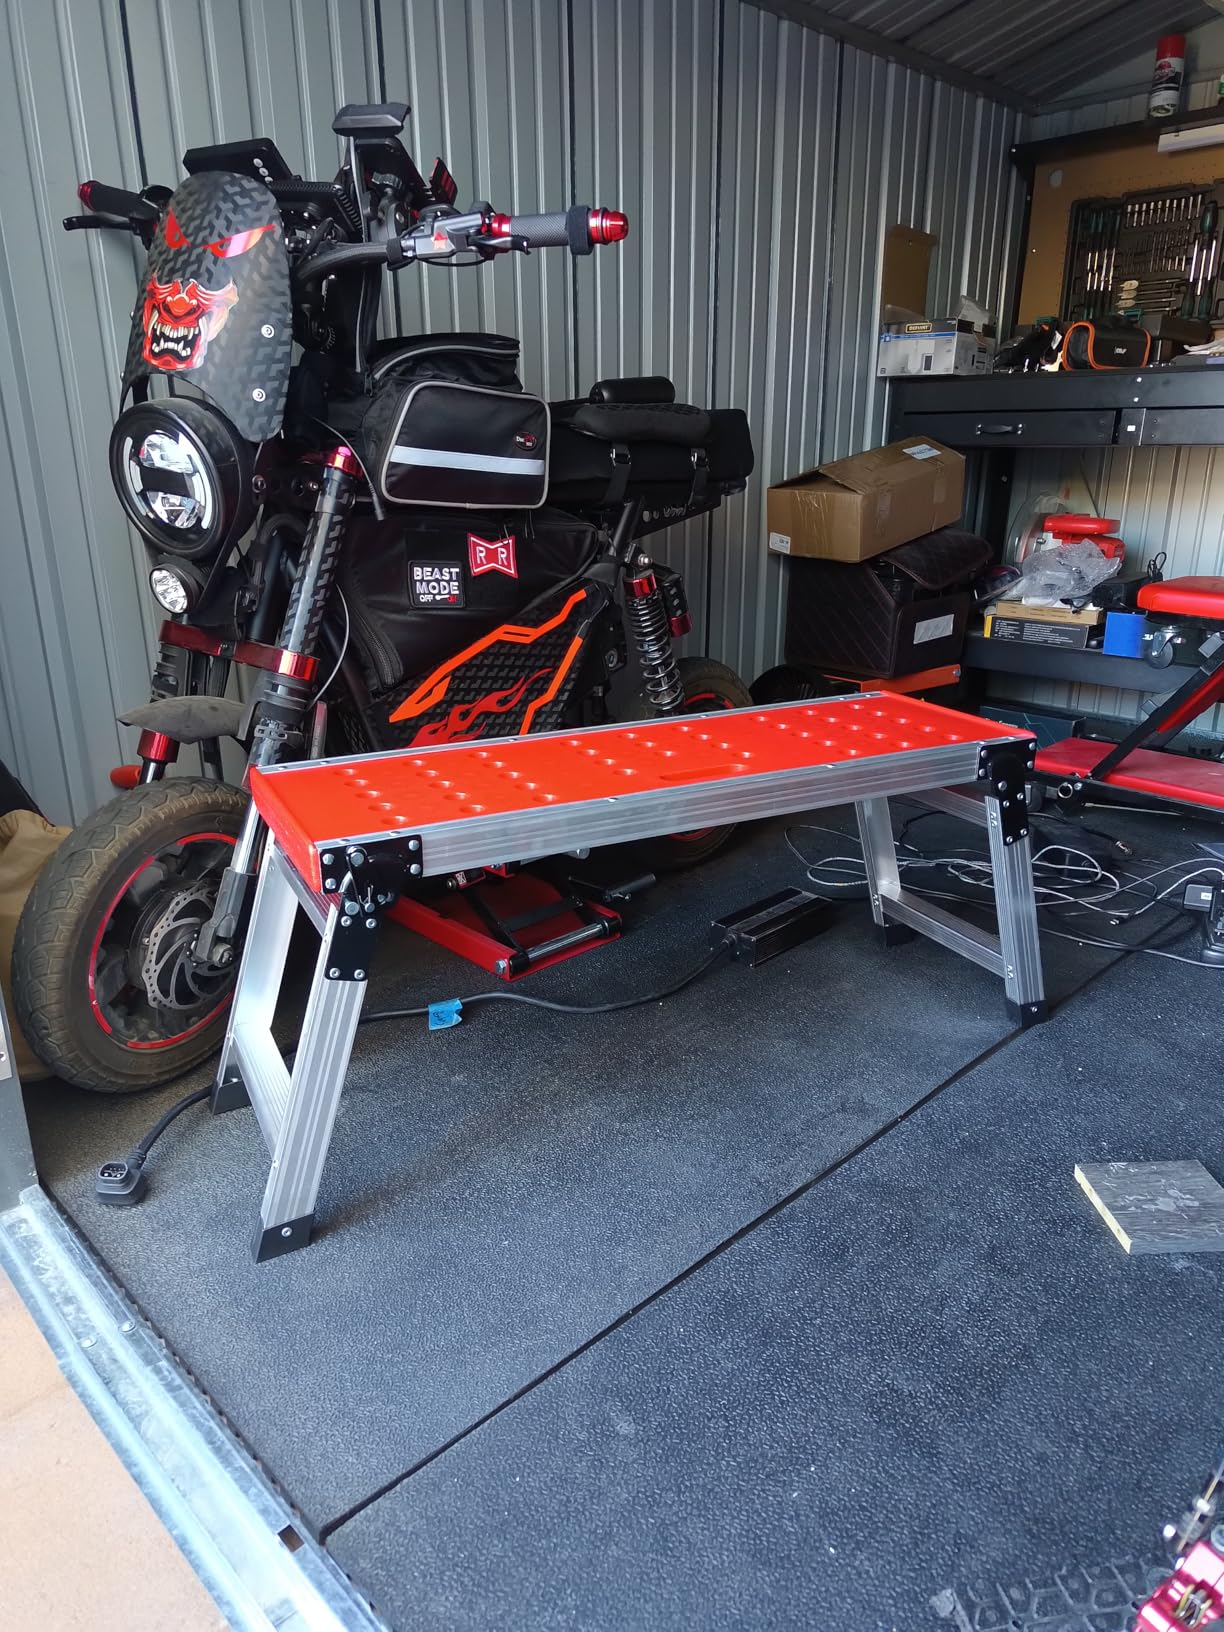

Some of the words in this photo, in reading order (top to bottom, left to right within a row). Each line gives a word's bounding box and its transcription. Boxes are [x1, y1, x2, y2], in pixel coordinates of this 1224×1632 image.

[476, 546, 487, 564] R
[497, 547, 508, 566] R
[413, 567, 460, 580] BEAST
[416, 581, 460, 594] MODE
[419, 594, 434, 602] OFF
